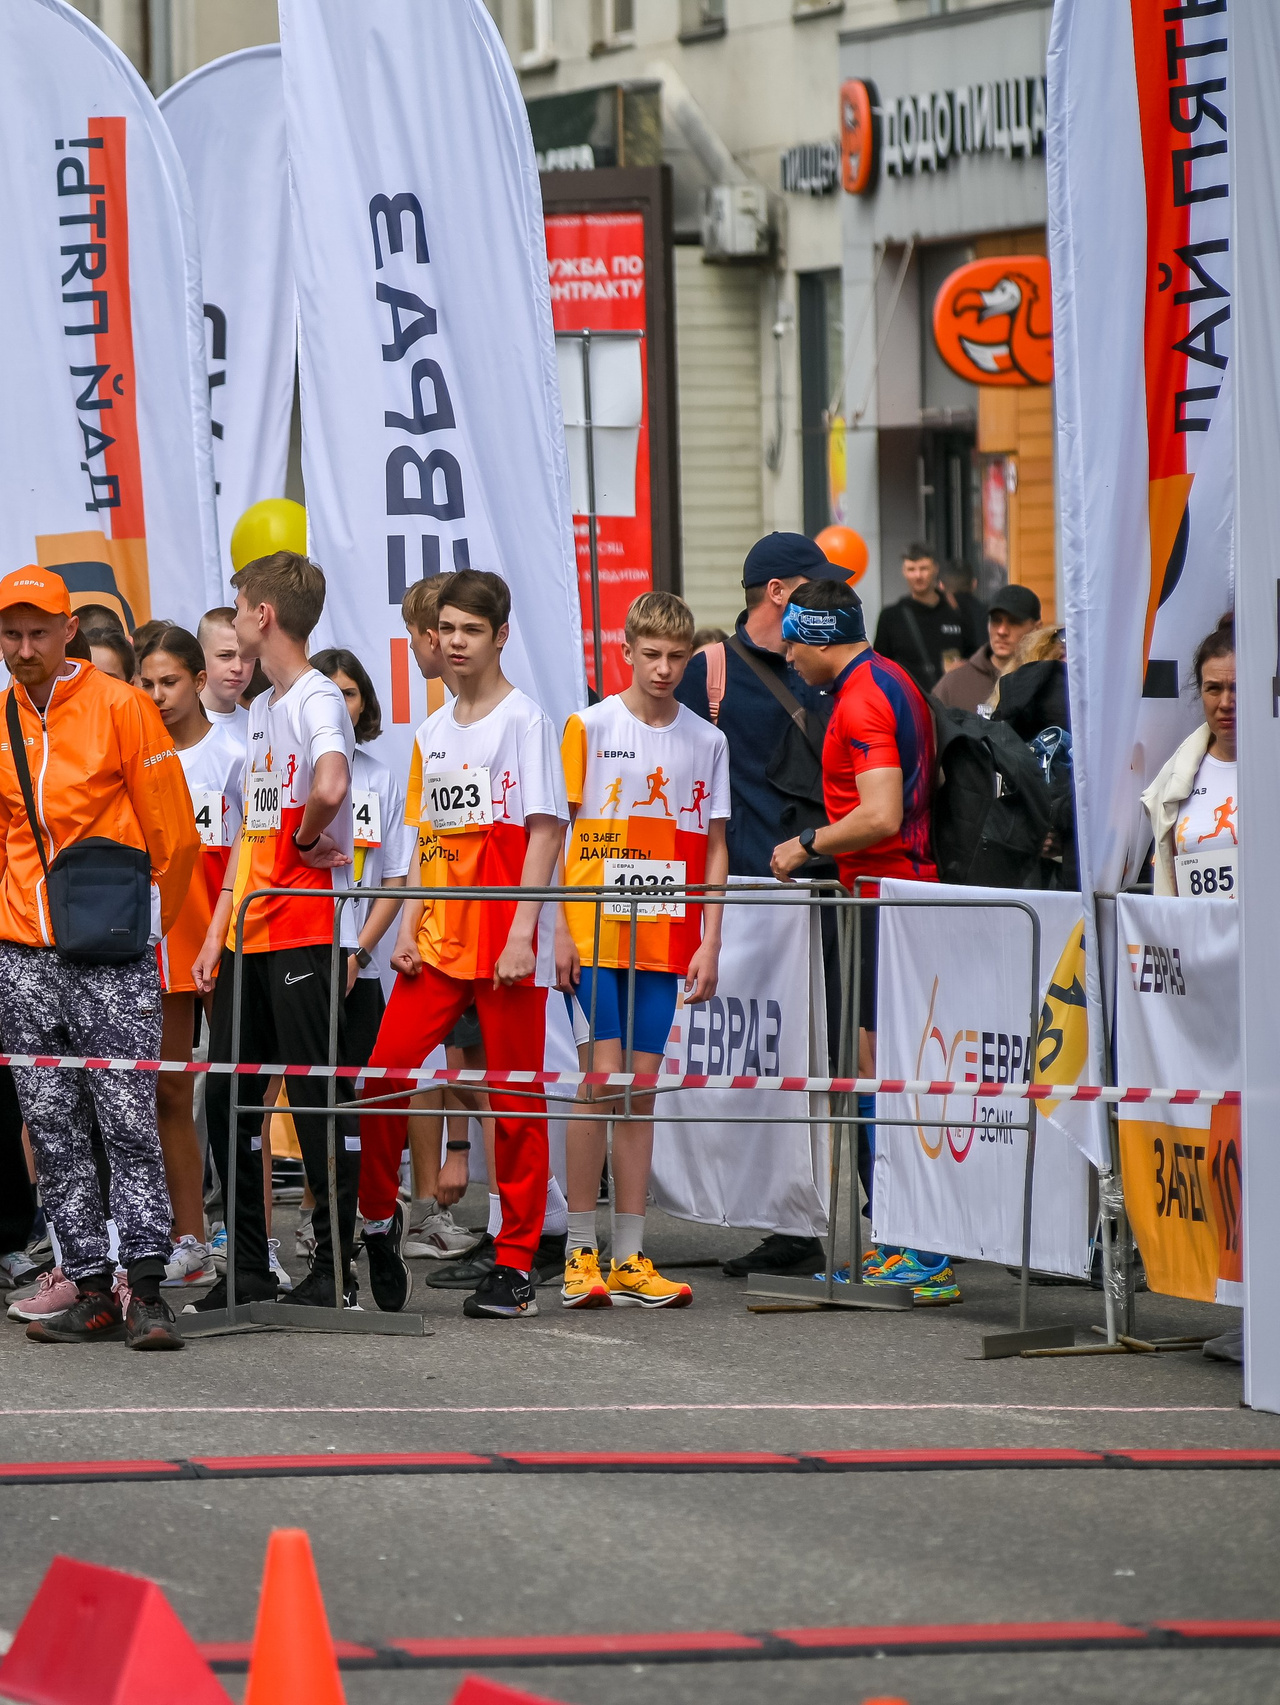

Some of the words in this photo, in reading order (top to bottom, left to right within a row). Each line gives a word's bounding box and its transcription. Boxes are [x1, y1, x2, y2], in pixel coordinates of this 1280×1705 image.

[548, 257, 608, 277] УЖБА
[612, 256, 644, 275] ПО
[550, 278, 643, 300] ОНТРАКТУ
[604, 750, 636, 759] ЕВРАЗ
[254, 787, 278, 812] 1008
[430, 784, 481, 812] 1023
[579, 833, 590, 842] 10
[580, 843, 608, 861] ДАЙ
[1190, 865, 1235, 896] 885
[1139, 945, 1186, 996] ЕВРАЗ
[686, 995, 781, 1077] ЕВРАЗ
[982, 1031, 1032, 1085] ЕВРА
